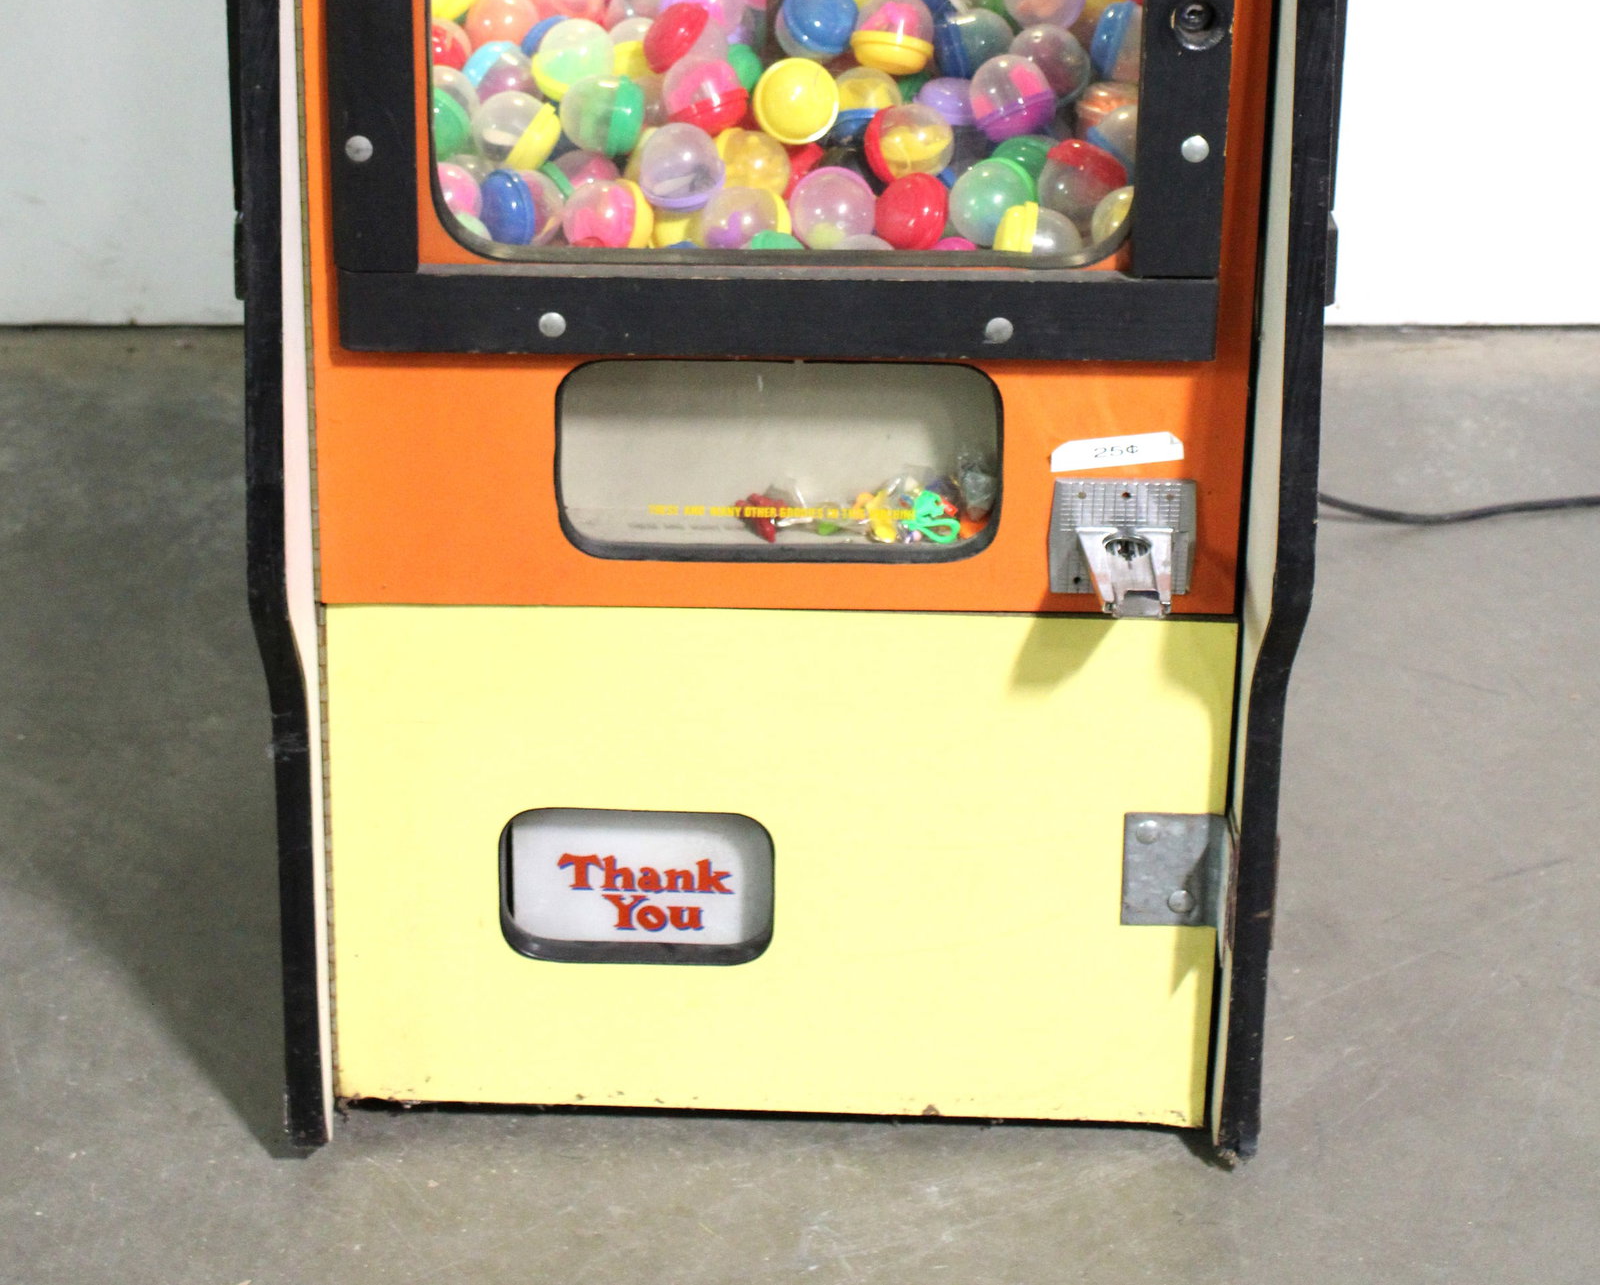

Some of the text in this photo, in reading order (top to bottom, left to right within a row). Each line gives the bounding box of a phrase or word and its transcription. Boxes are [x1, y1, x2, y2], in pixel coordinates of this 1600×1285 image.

[1094, 445, 1138, 458] 25¢
[744, 506, 777, 518] OTHER
[557, 852, 735, 894] Thank
[601, 894, 706, 932] You
